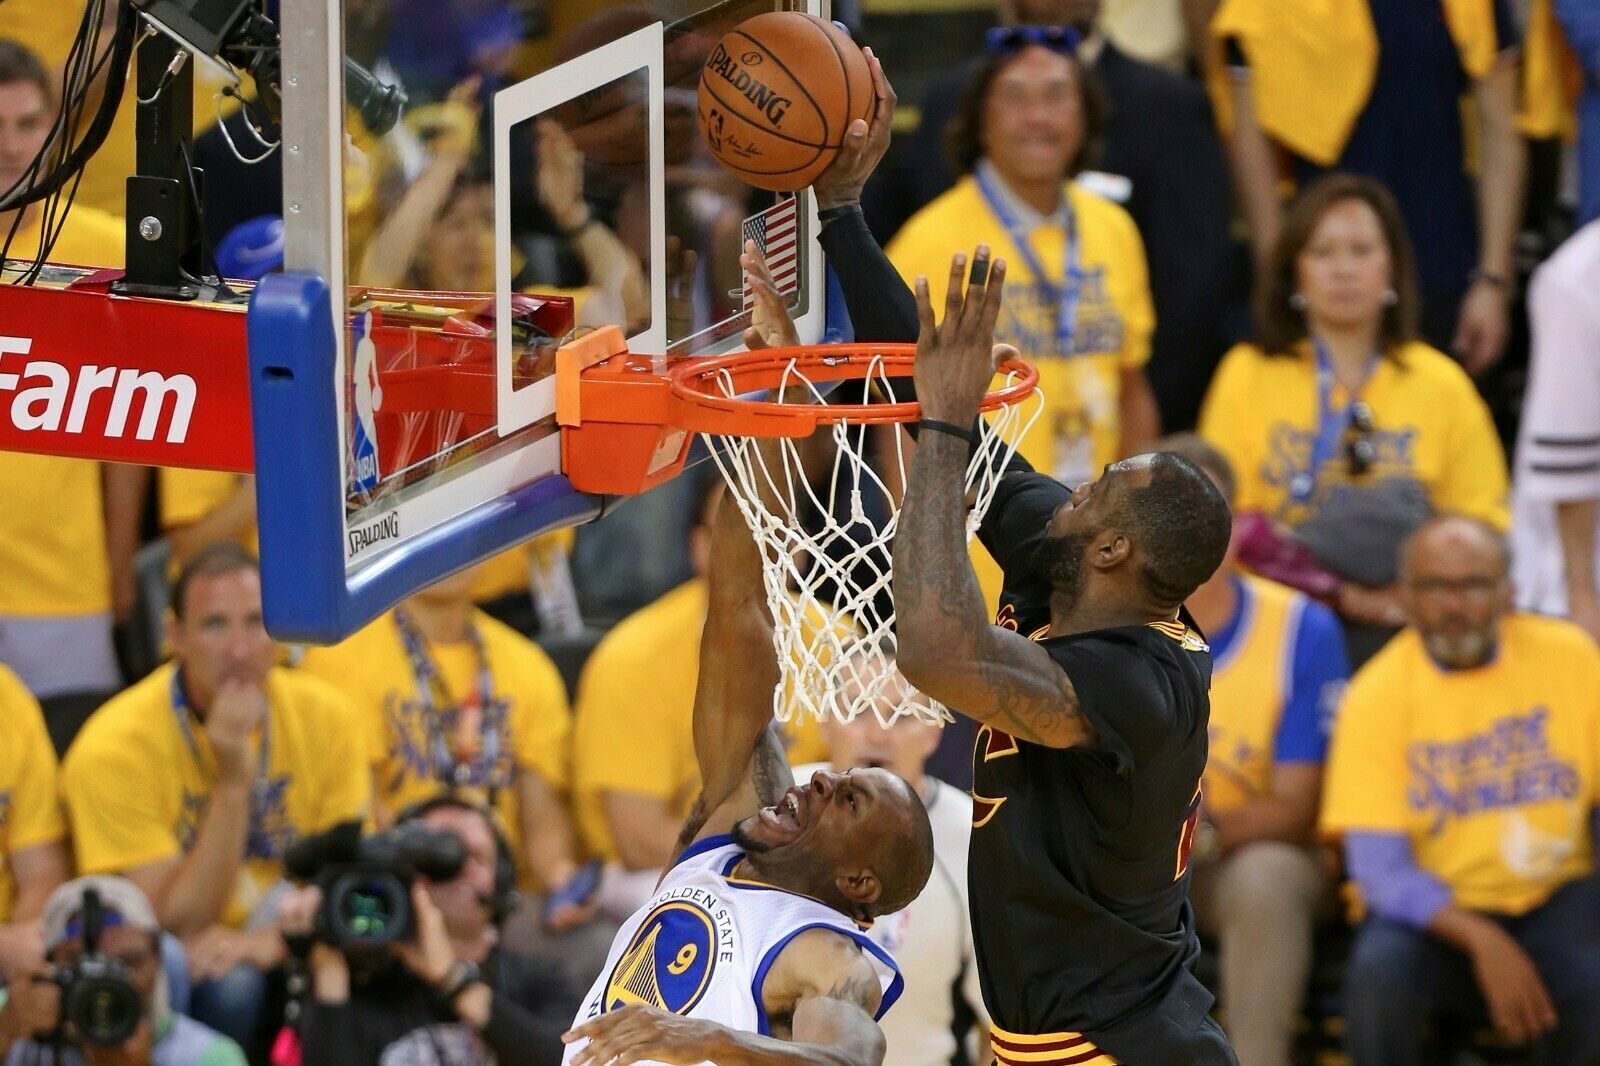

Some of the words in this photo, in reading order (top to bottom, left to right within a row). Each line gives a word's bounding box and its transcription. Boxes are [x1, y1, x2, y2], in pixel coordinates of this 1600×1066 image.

[704, 43, 792, 126] SPALDING
[0, 336, 197, 444] Farm
[349, 511, 398, 557] SPALDING
[667, 943, 697, 975] 9
[715, 909, 734, 963] STATE
